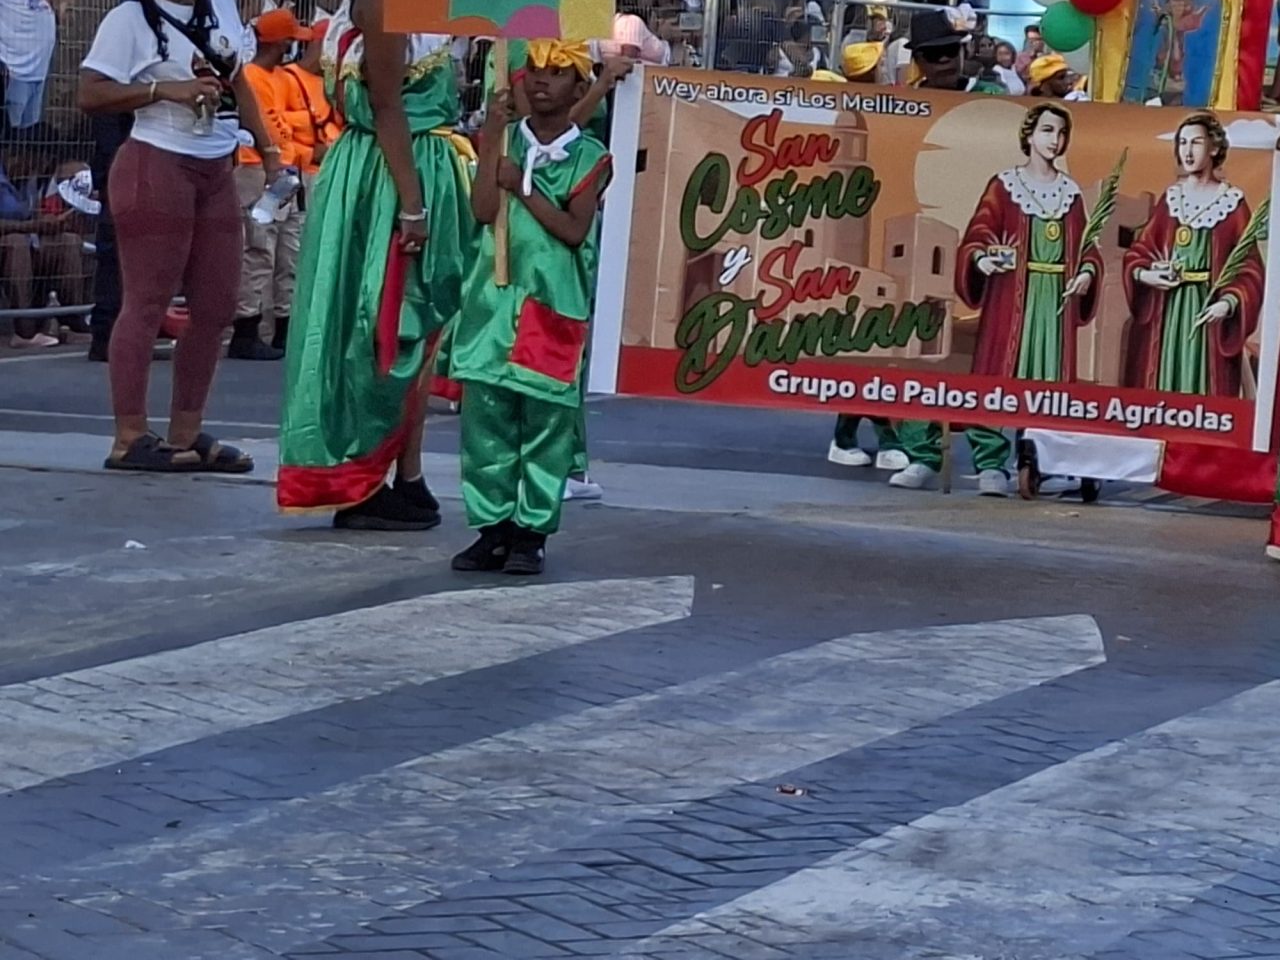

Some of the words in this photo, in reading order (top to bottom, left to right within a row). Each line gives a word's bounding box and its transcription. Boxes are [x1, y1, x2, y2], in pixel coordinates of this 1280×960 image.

[653, 76, 701, 101] Wey
[706, 79, 768, 104] ahora
[842, 92, 931, 116] Mellizos
[737, 109, 840, 186] San
[680, 152, 881, 252] Cosme
[719, 246, 752, 285] y
[754, 240, 861, 321] San
[768, 369, 855, 402] Grupo
[862, 375, 896, 402] de
[903, 379, 977, 410] Palos
[984, 384, 1018, 413] de
[1024, 388, 1099, 420] Villas
[1104, 395, 1234, 433] Agrícolas
